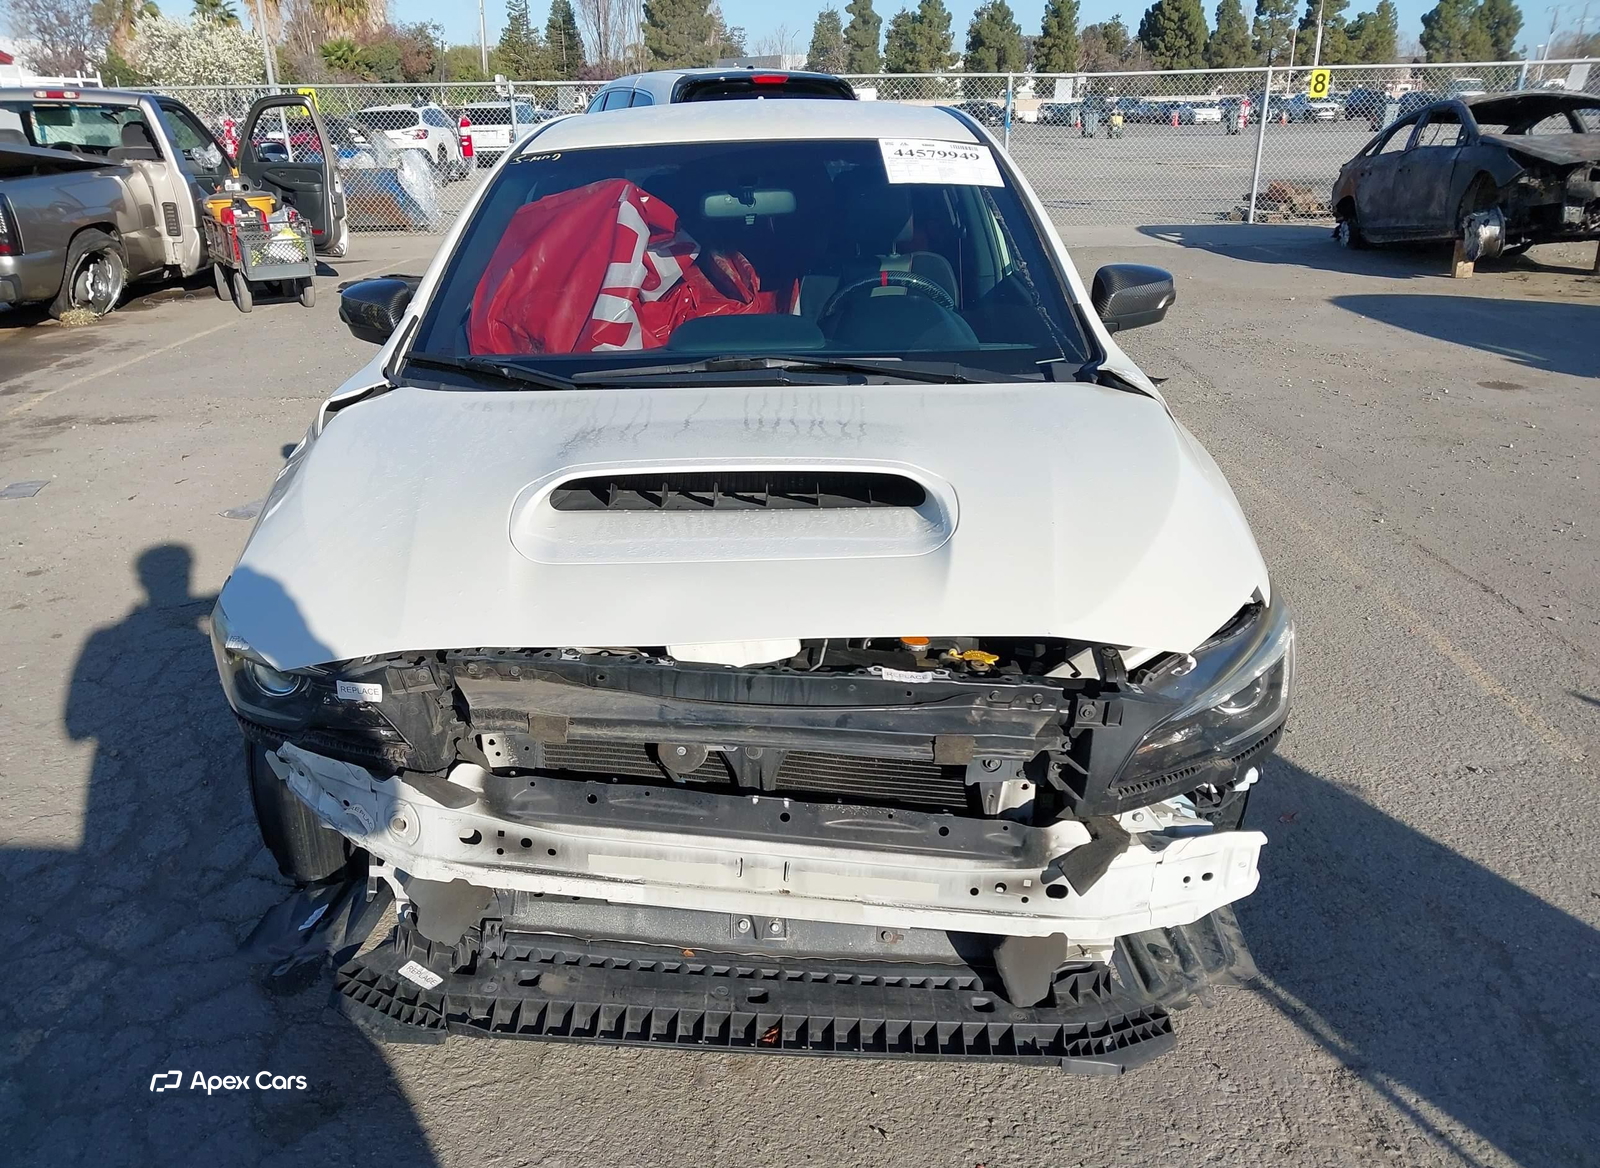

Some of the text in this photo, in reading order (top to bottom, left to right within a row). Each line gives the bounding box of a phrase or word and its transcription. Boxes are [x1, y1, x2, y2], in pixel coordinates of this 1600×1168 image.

[1313, 73, 1327, 94] 8
[893, 149, 980, 161] 44579949
[887, 671, 928, 680] REPLACE
[340, 685, 380, 696] REPLACE
[406, 965, 438, 986] REPLACE
